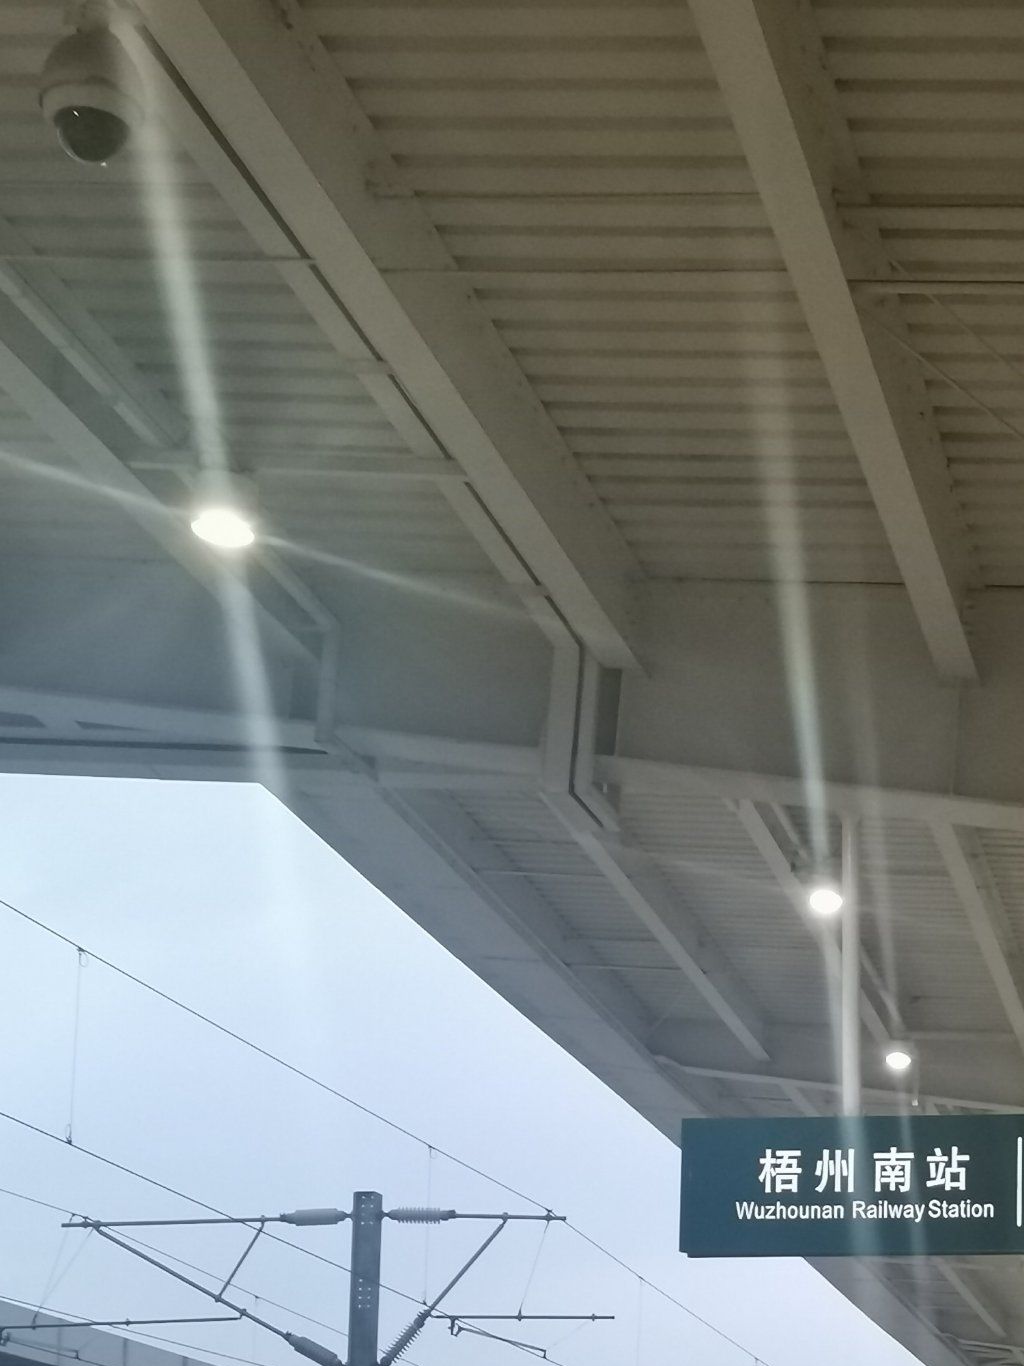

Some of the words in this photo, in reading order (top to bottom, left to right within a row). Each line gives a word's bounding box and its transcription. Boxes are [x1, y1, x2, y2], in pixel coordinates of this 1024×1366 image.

[759, 1146, 969, 1193] 梧州南站
[735, 1200, 844, 1220] Wuzhounan
[852, 1200, 925, 1222] Railway
[928, 1199, 994, 1218] Station
